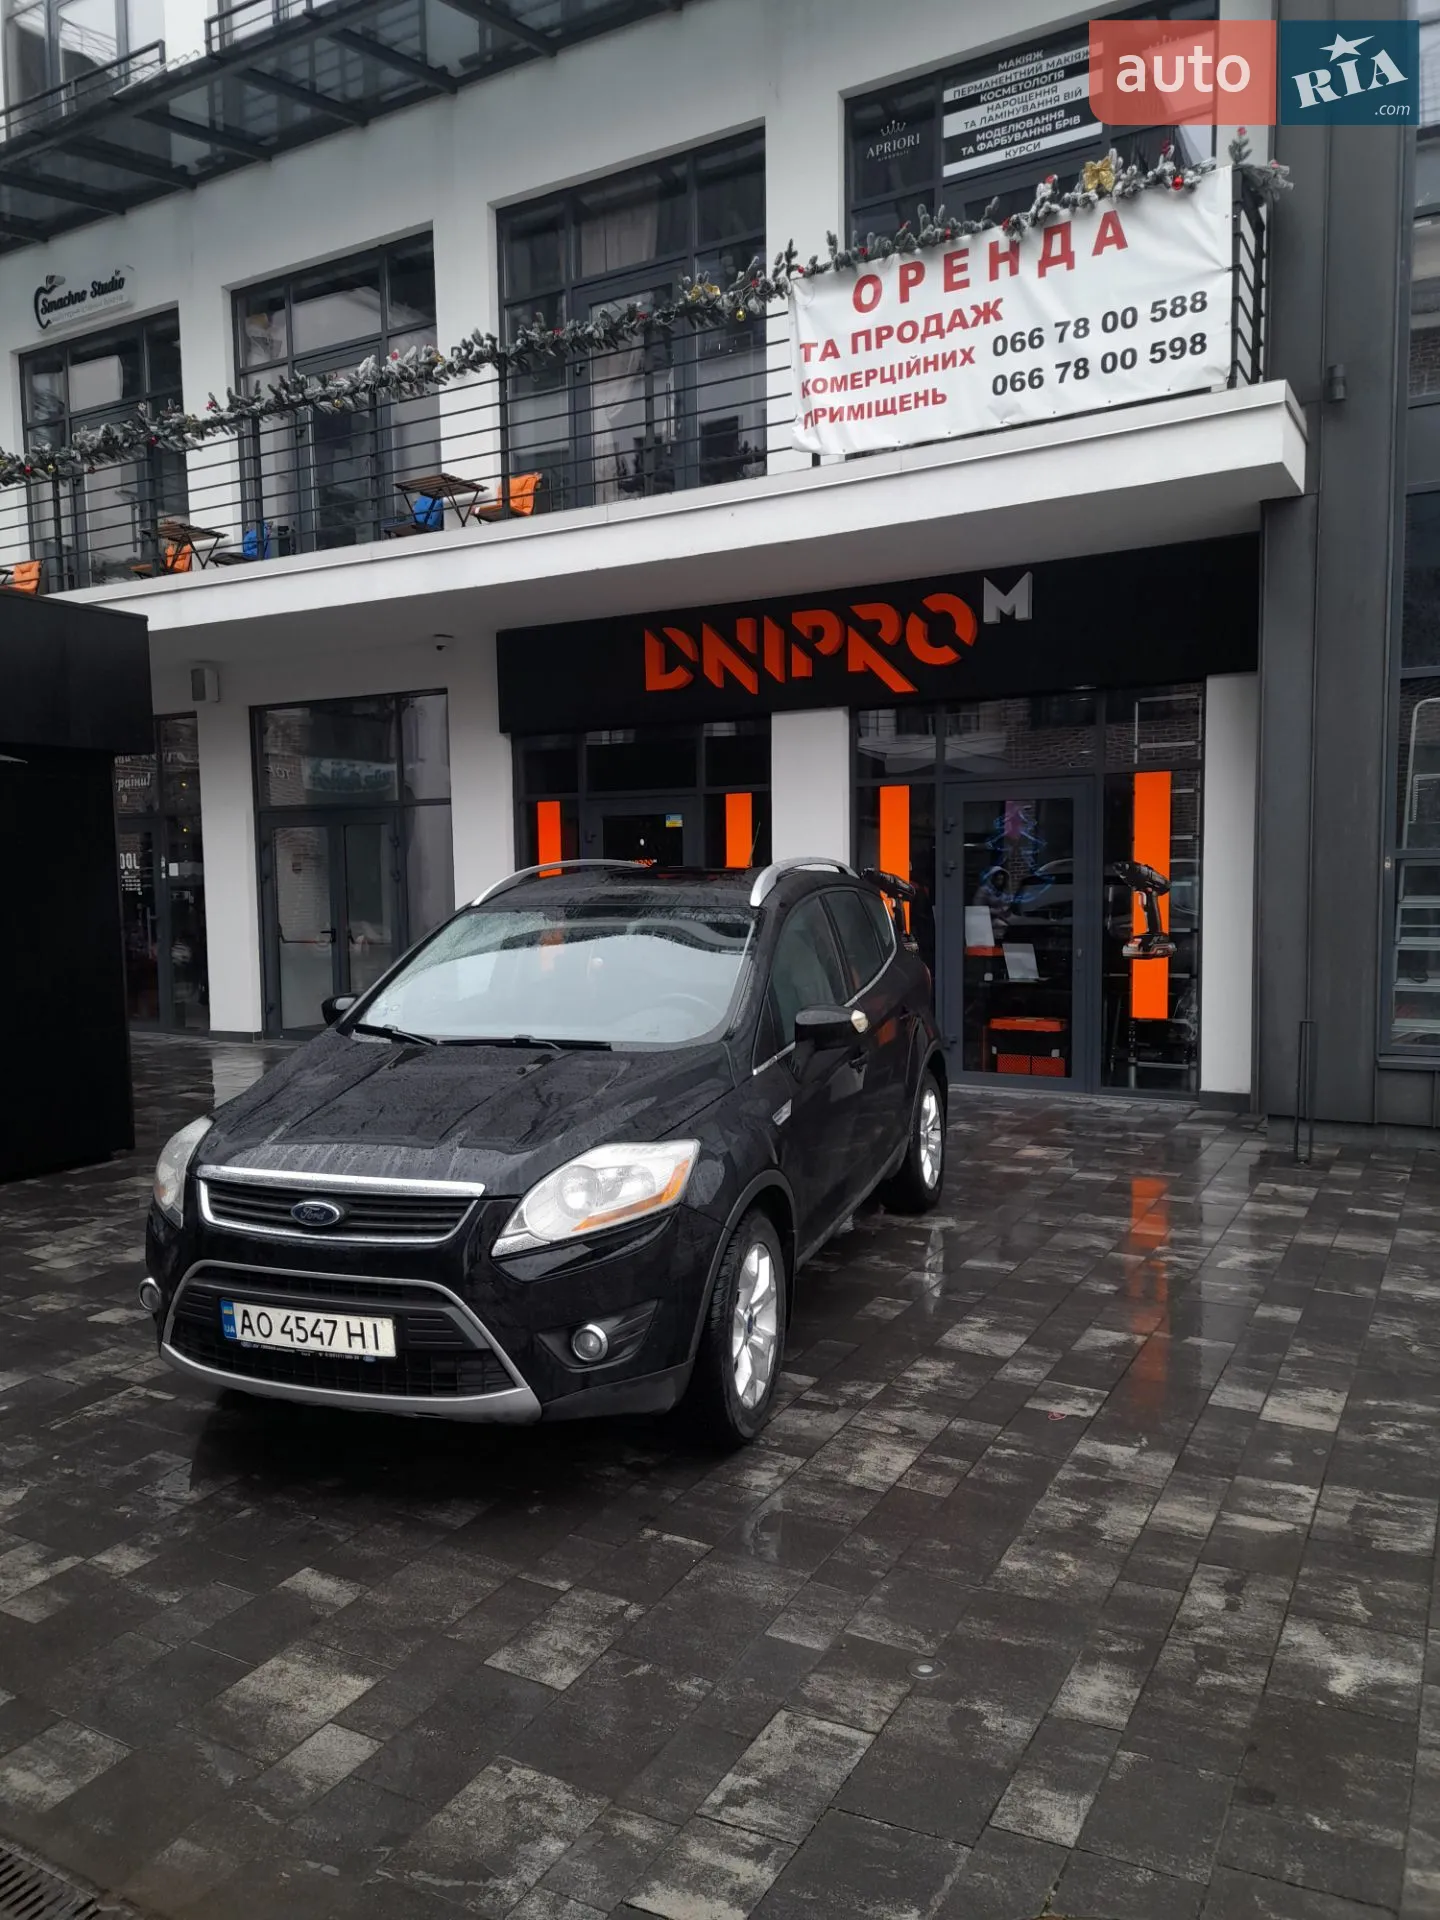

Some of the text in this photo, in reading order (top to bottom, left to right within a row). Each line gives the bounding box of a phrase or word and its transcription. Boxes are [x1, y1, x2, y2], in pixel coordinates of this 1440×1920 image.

[953, 62, 1043, 99] ПЕРМАНЕНТНИЙ
[998, 50, 1044, 71] МАКІЯЖ
[980, 70, 1065, 103] КОСМЕТОЛОГІЯ
[986, 85, 1058, 113] НАРОЩЕННЯ
[964, 87, 1083, 130] ТА ЛАМІНУВАННЯ ВІЙ
[976, 109, 1065, 142] МОДЕЛЮВАННЯ
[866, 132, 920, 159] APRIORI
[961, 115, 1081, 156] ТА ФАРБУВАННЯ БРІВ
[1005, 141, 1042, 159] КУРСИ
[852, 210, 1129, 314] ОРЕНДА
[41, 290, 87, 315] Smachno
[90, 276, 125, 298] Studio
[800, 298, 1004, 363] ТА ПРОДАЖ
[992, 290, 1209, 357] 066 78 00 588
[801, 346, 976, 399] КОМЕРЦІЙНИХ
[992, 332, 1208, 397] 066 78 00 598
[803, 389, 948, 430] ПРИМІЩЕНЬ
[644, 571, 1033, 695] DNIPRO M
[300, 1206, 327, 1221] Ford
[224, 1325, 235, 1334] UA
[241, 1309, 380, 1351] AO 4547 HI
